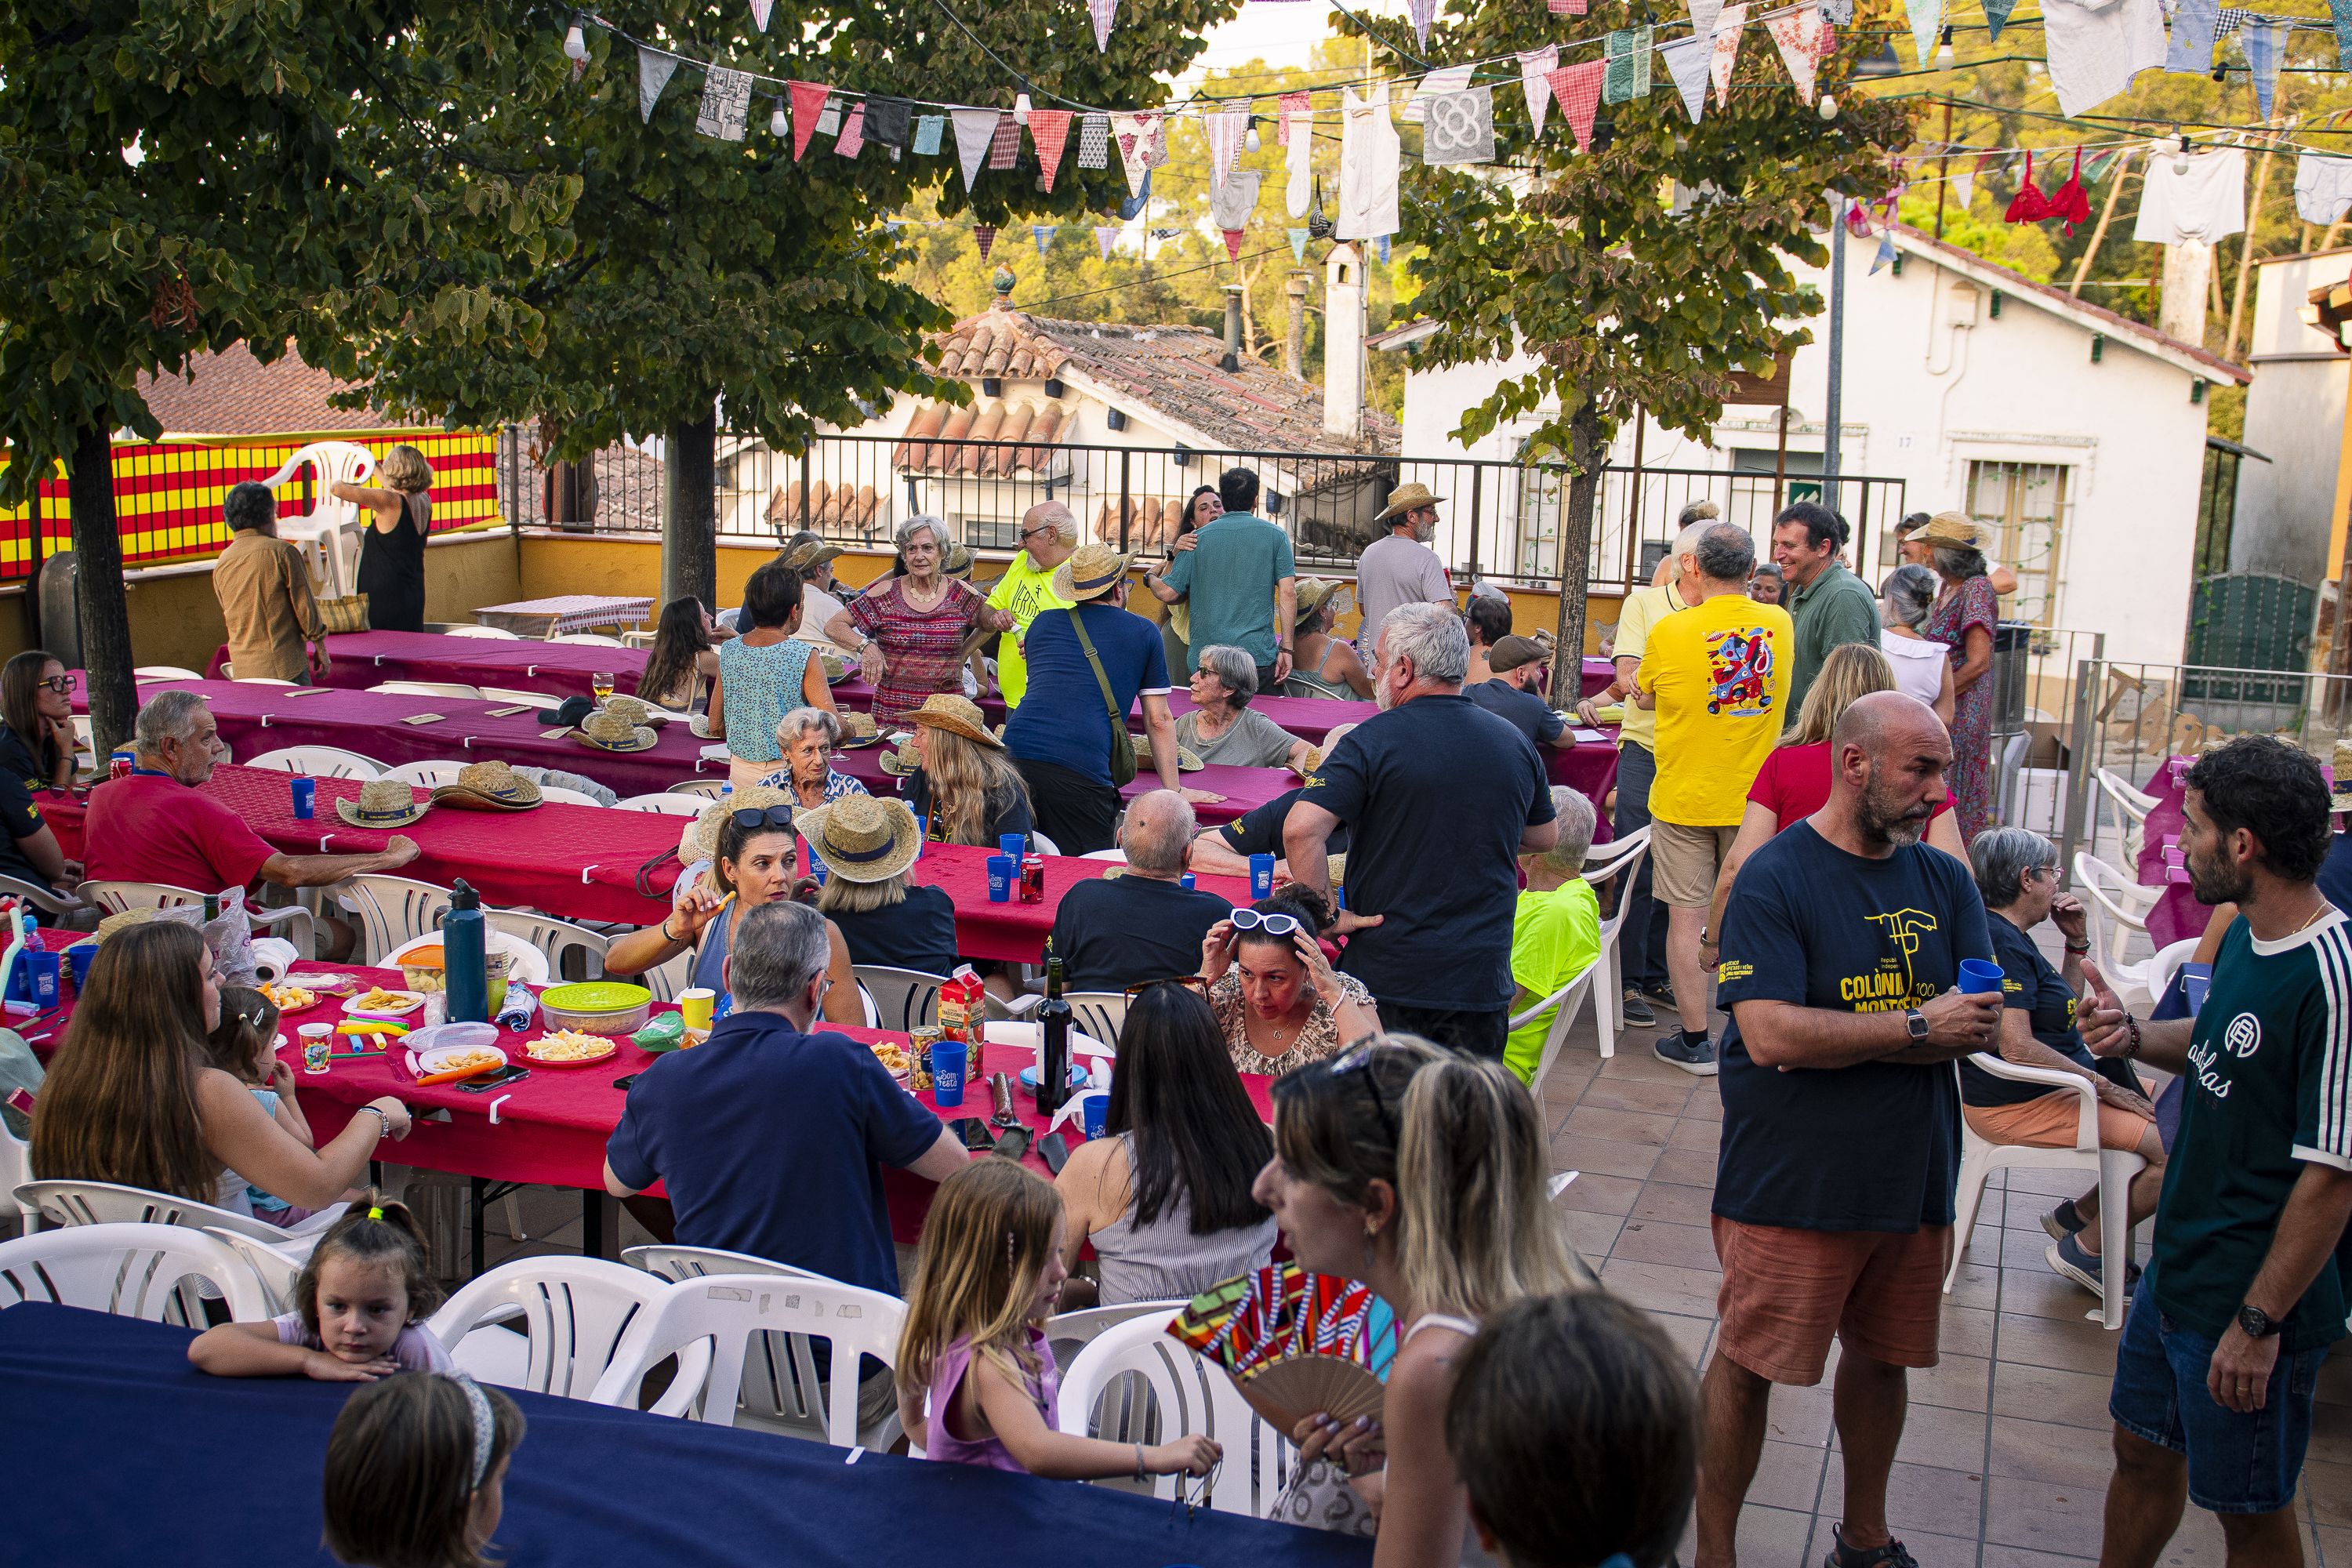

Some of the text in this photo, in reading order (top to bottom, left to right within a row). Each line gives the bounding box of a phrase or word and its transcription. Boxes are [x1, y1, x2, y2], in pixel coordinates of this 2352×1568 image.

[1899, 437, 1911, 448] 17
[941, 1069, 956, 1080] Som
[936, 1076, 957, 1088] festa
